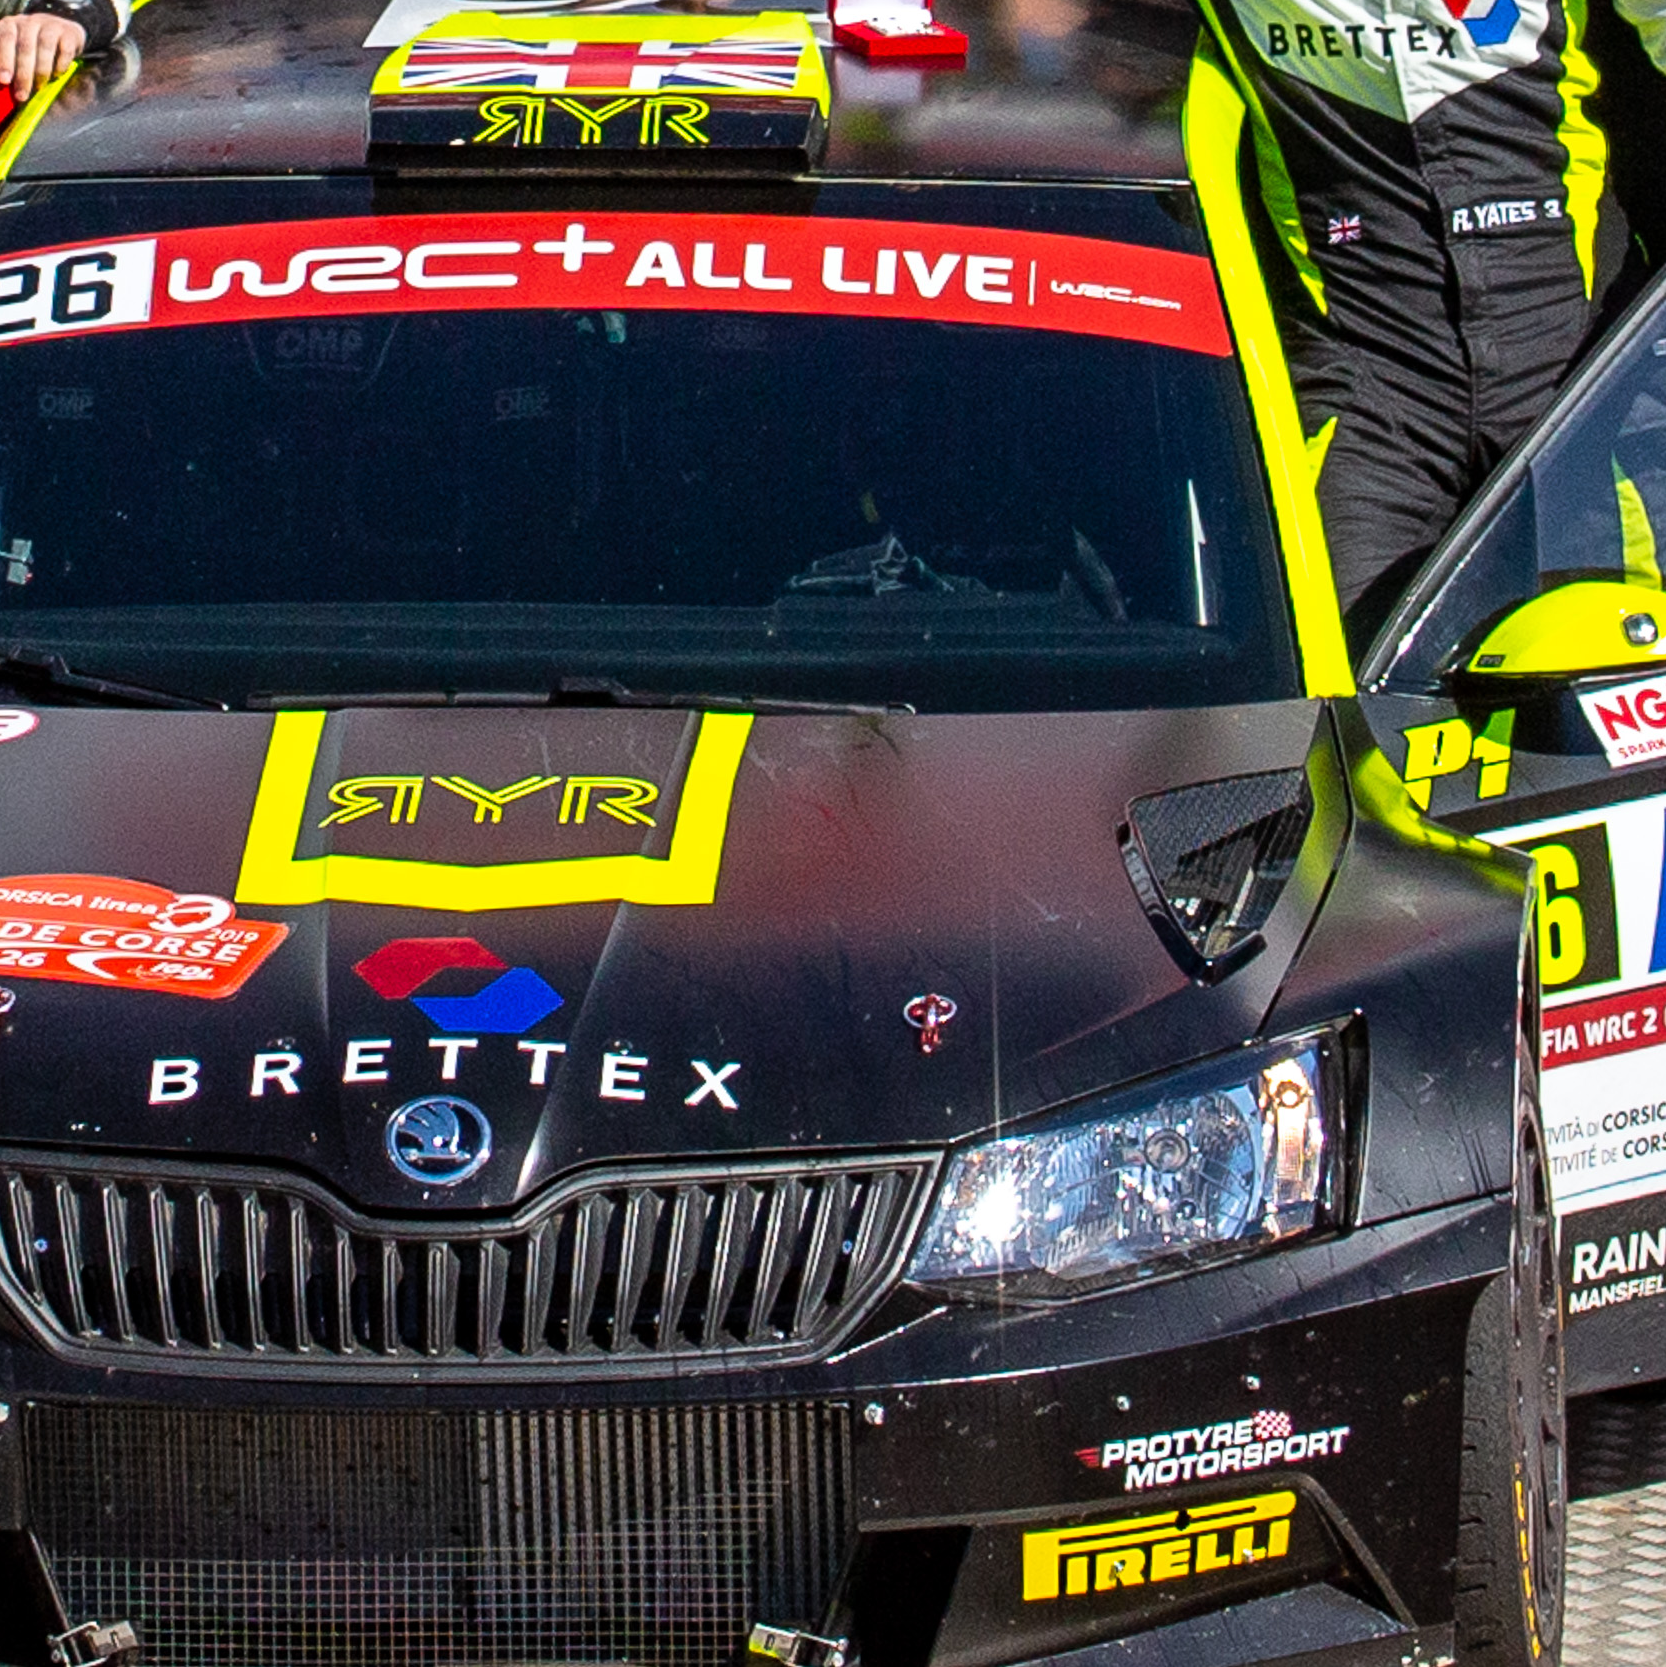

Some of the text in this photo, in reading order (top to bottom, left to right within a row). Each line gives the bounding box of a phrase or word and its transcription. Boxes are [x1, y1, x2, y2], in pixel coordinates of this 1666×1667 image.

[1266, 22, 1458, 61] BRETTEX
[625, 241, 793, 291] ALL
[821, 246, 1015, 304] LIVE
[1617, 739, 1666, 760] SPARK
[90, 894, 160, 917] linea
[79, 926, 249, 964] CORSE
[205, 926, 259, 943] 2019
[150, 960, 216, 982] IGOL
[1541, 1023, 1579, 1058] FIA
[1584, 1012, 1637, 1048] WRC
[1642, 1008, 1658, 1035] 2
[147, 1037, 743, 1111] BRETTEX
[1550, 1142, 1598, 1177] TIVITÉ
[1101, 1417, 1255, 1469] PROTYRE
[1124, 1426, 1351, 1492] MOTORSPORT
[1022, 1490, 1298, 1602] PIRELLI
